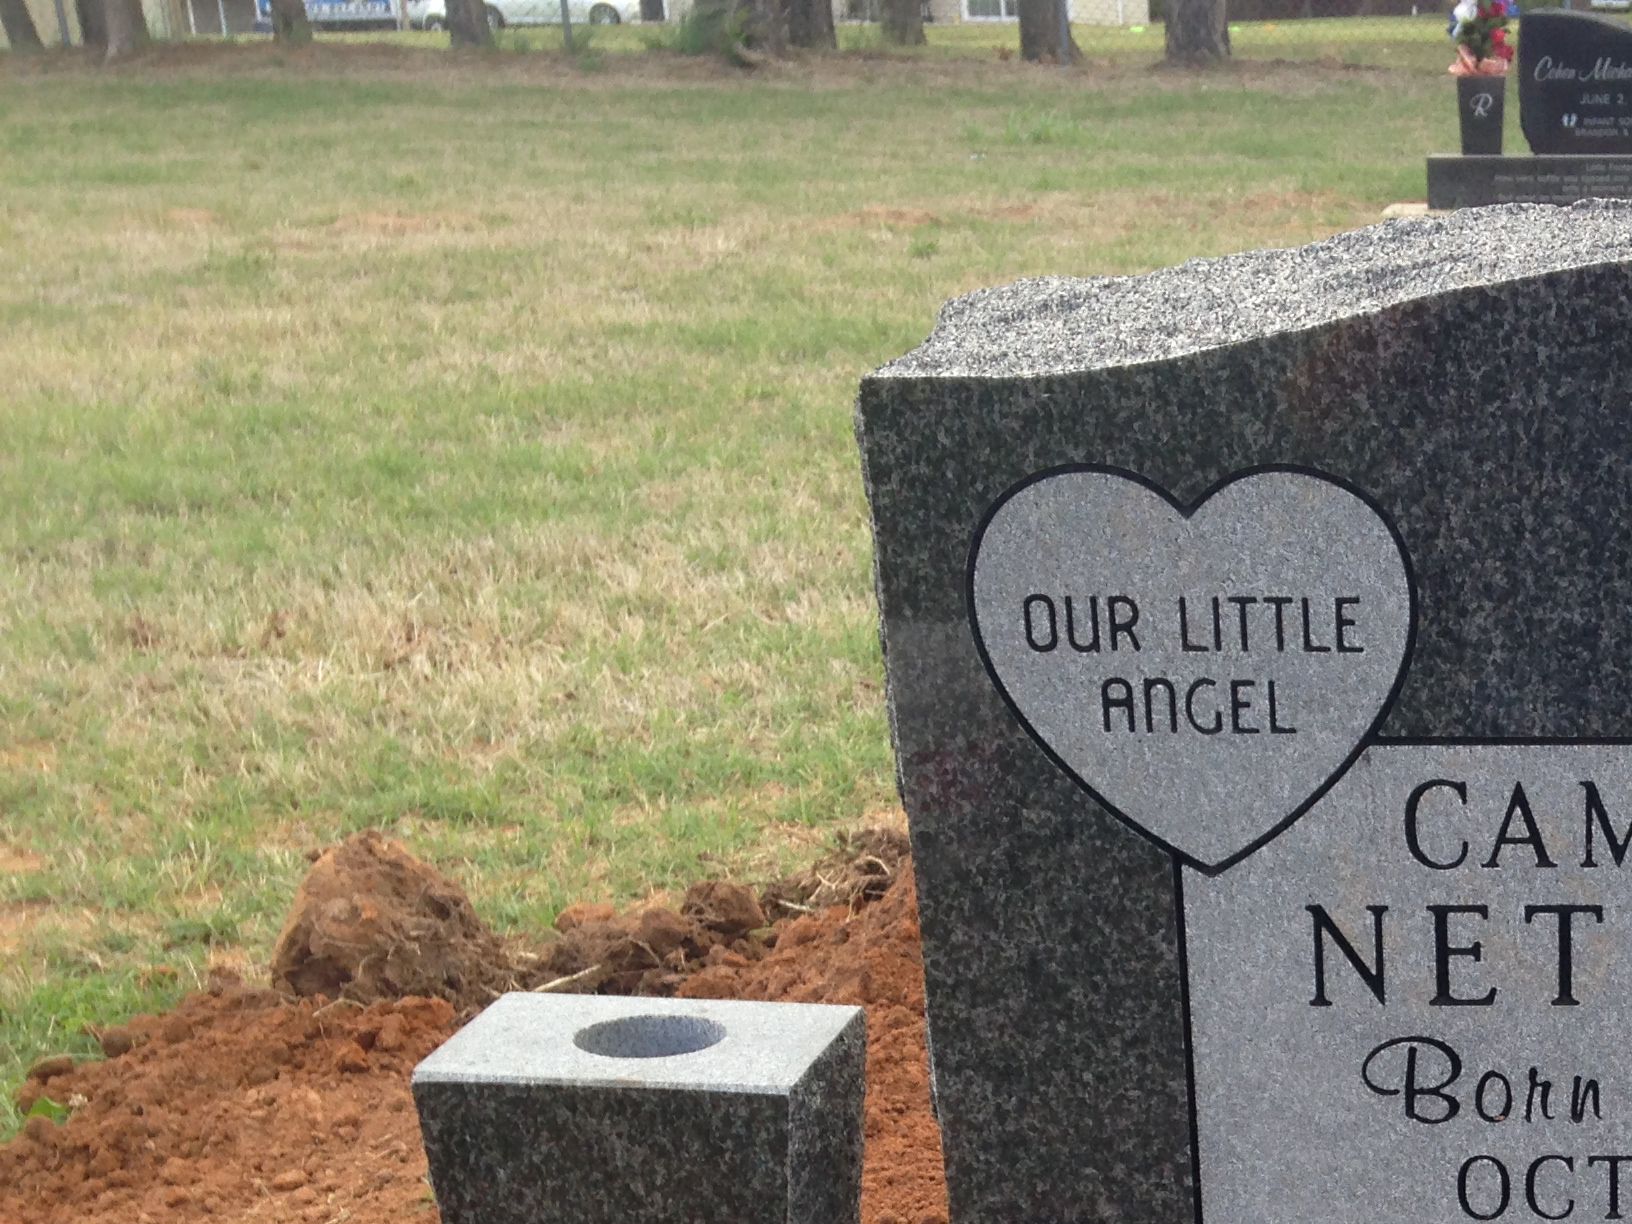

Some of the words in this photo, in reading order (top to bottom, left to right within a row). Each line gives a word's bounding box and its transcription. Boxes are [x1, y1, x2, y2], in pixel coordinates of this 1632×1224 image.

[1470, 93, 1492, 118] R
[1580, 93, 1611, 105] JUNE
[1022, 593, 1142, 654] OUR
[1178, 595, 1365, 653] LITTLE
[1100, 676, 1298, 736] ANGEL
[1361, 1035, 1604, 1125] Born
